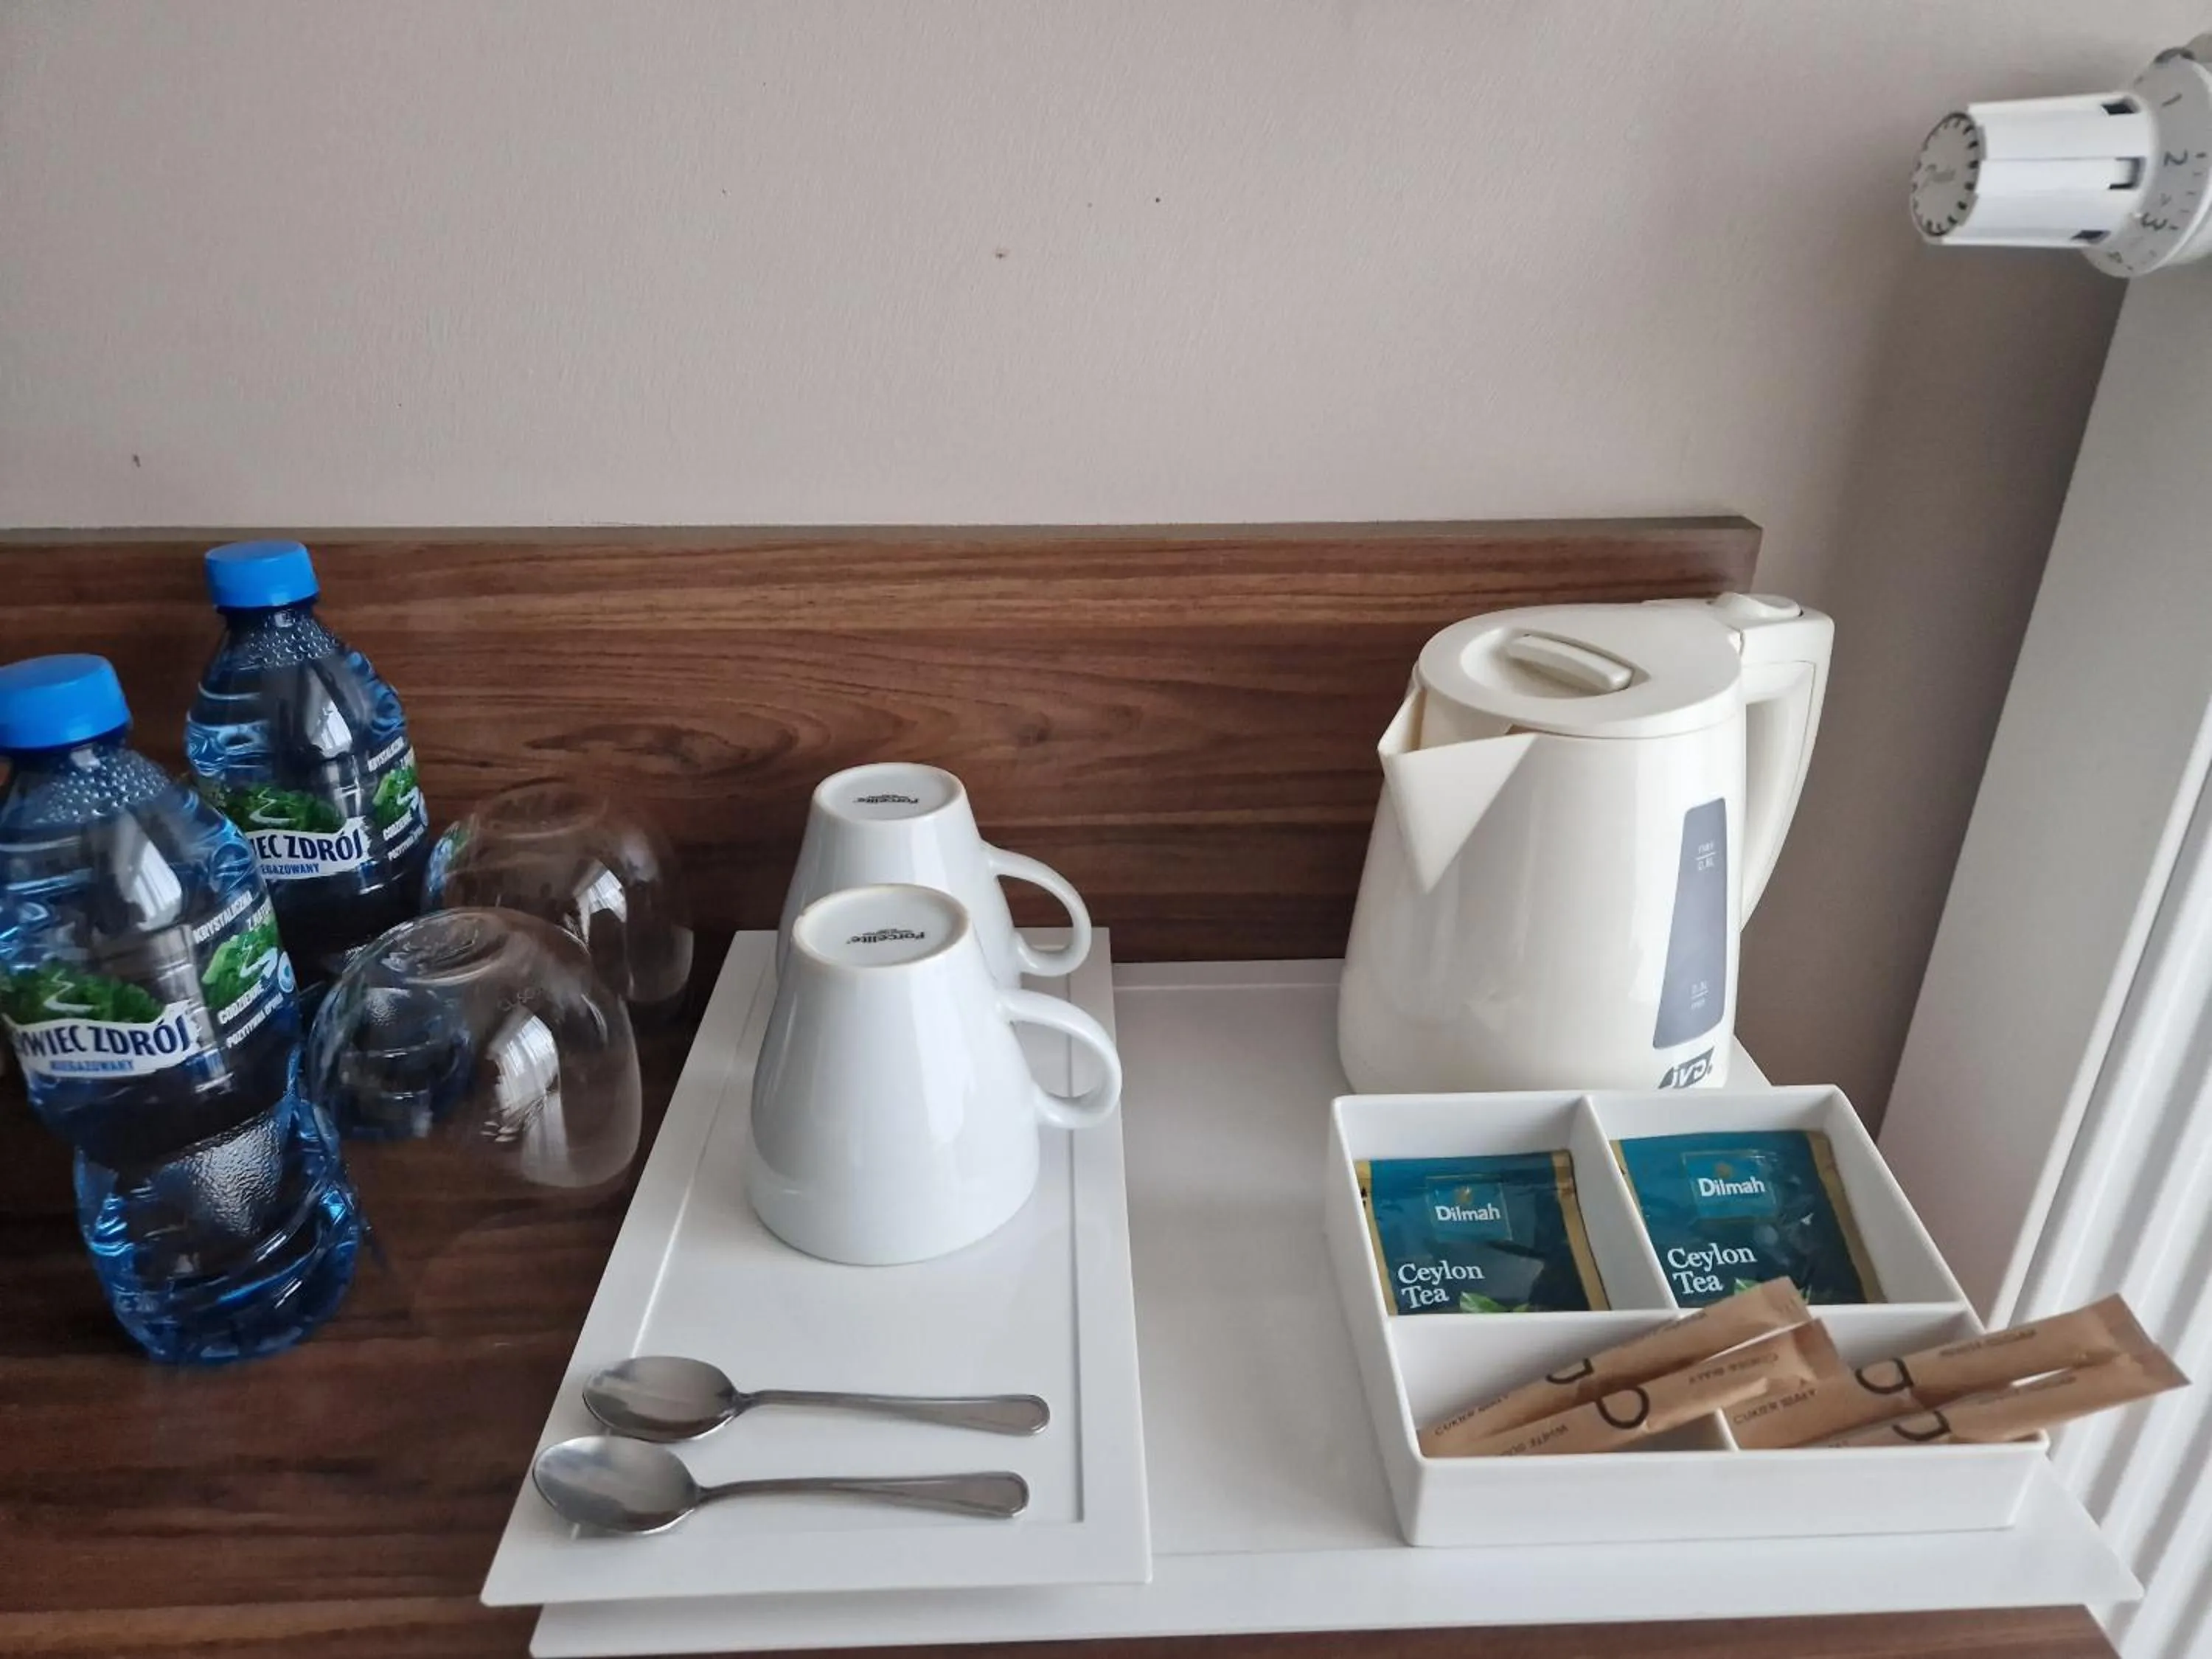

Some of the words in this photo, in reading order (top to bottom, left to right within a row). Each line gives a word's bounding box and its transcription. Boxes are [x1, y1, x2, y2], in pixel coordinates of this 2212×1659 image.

[2163, 150, 2188, 167] 2
[2140, 212, 2168, 232] 3
[282, 828, 363, 862] ZDRÓJ
[86, 1014, 191, 1056] ZDRÓJ
[1698, 1176, 1766, 1197] Dilmah
[1434, 1203, 1501, 1222] Dilmah
[1667, 1242, 1758, 1272] Ceylon
[1397, 1259, 1486, 1285] Ceylon
[1672, 1270, 1724, 1295] Tea
[1401, 1285, 1450, 1309] Tea
